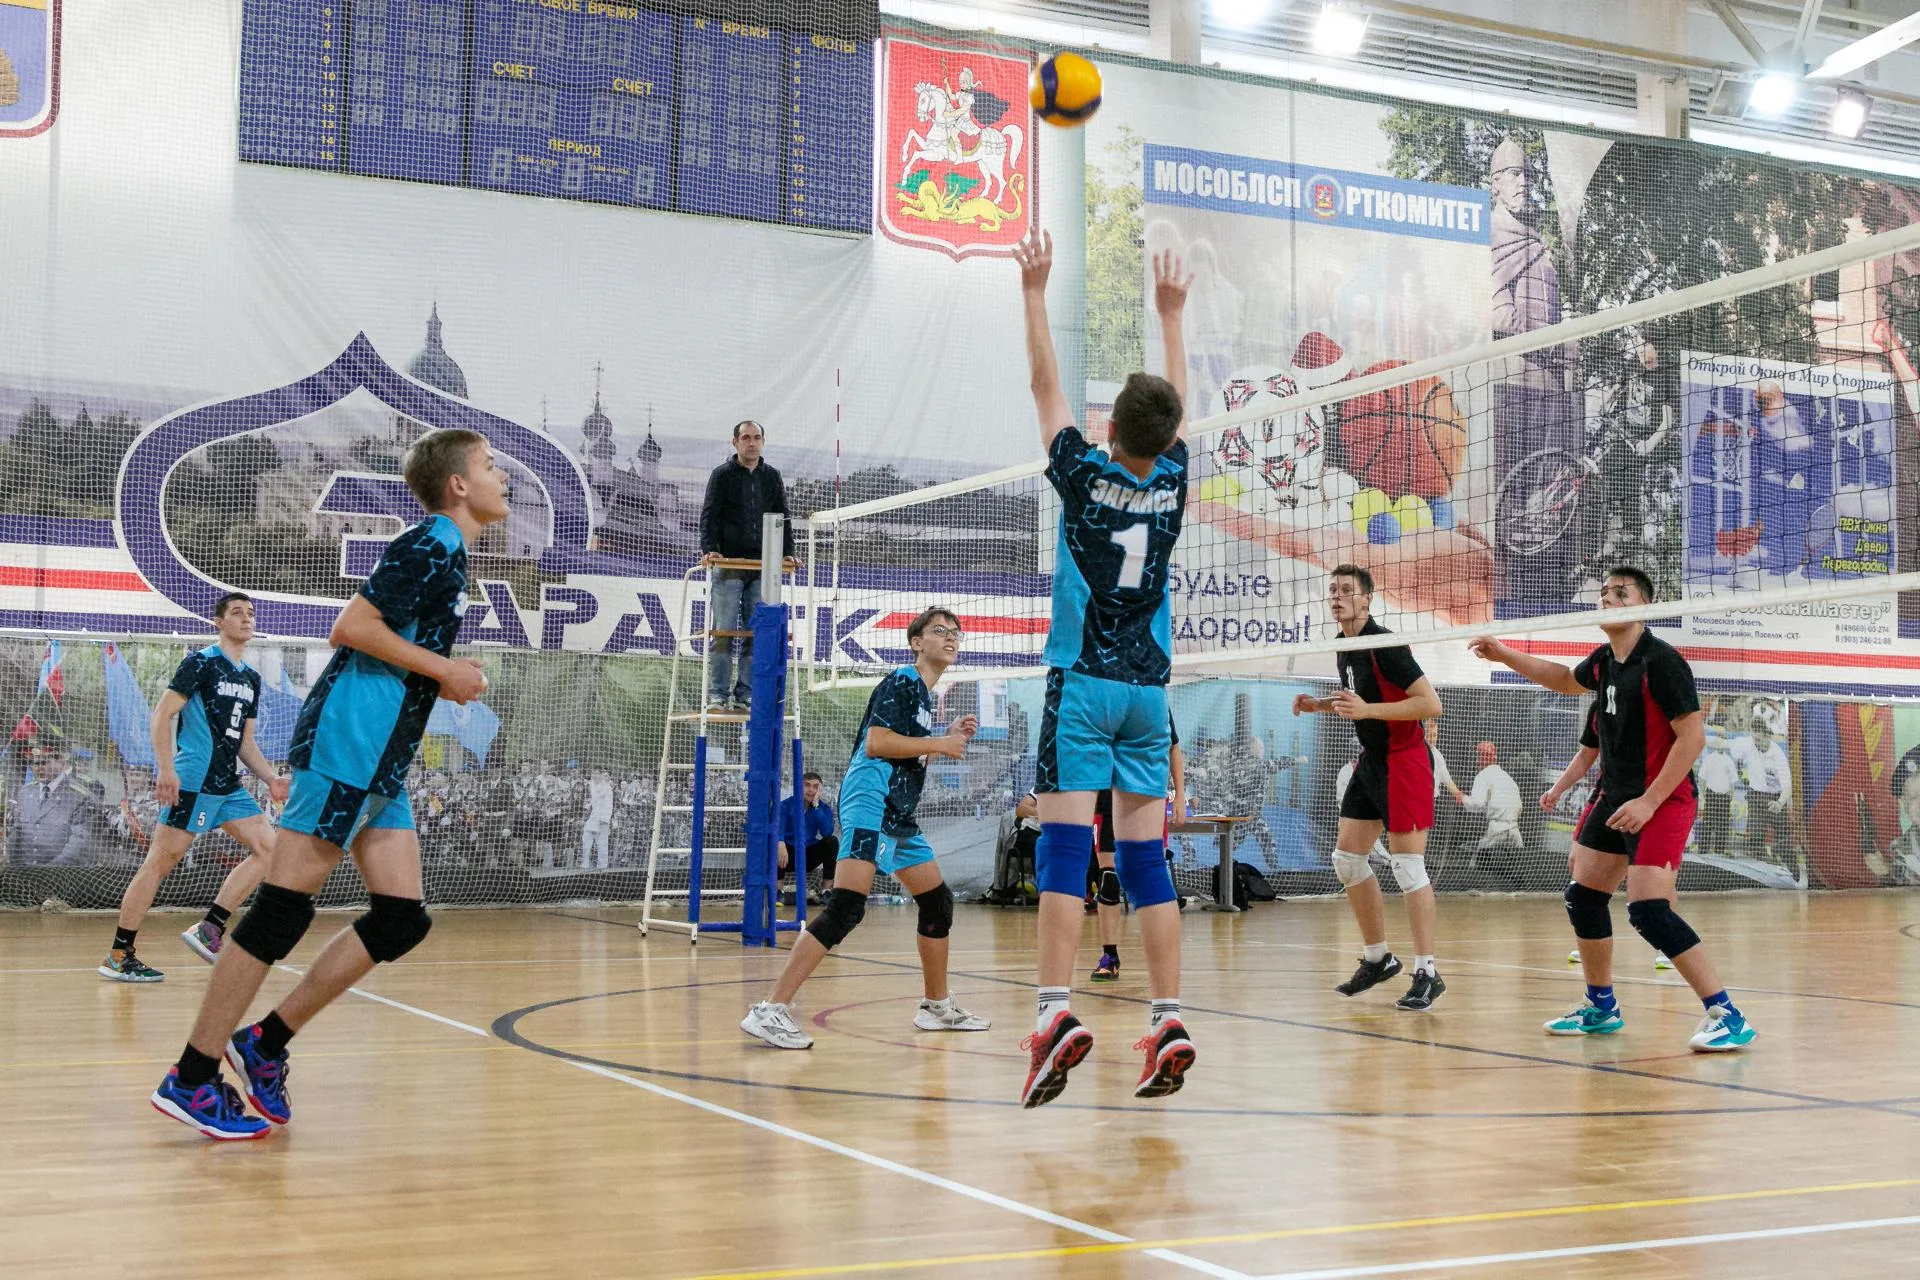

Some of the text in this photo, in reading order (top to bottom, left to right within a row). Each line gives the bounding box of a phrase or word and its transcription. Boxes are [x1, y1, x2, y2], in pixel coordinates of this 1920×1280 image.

[587, 1, 638, 20] ВРЕМЯ
[722, 21, 770, 39] ВРЕМЯ
[323, 71, 336, 81] 10
[493, 61, 654, 96] СЧЕТ СЧЕТ
[322, 103, 335, 113] 12
[549, 138, 601, 157] ПЕРИОД
[1688, 356, 1746, 377] Открой
[1749, 363, 1785, 380] Окно
[1799, 370, 1829, 387] Мир
[1110, 523, 1149, 588] 1
[230, 701, 244, 728] 5
